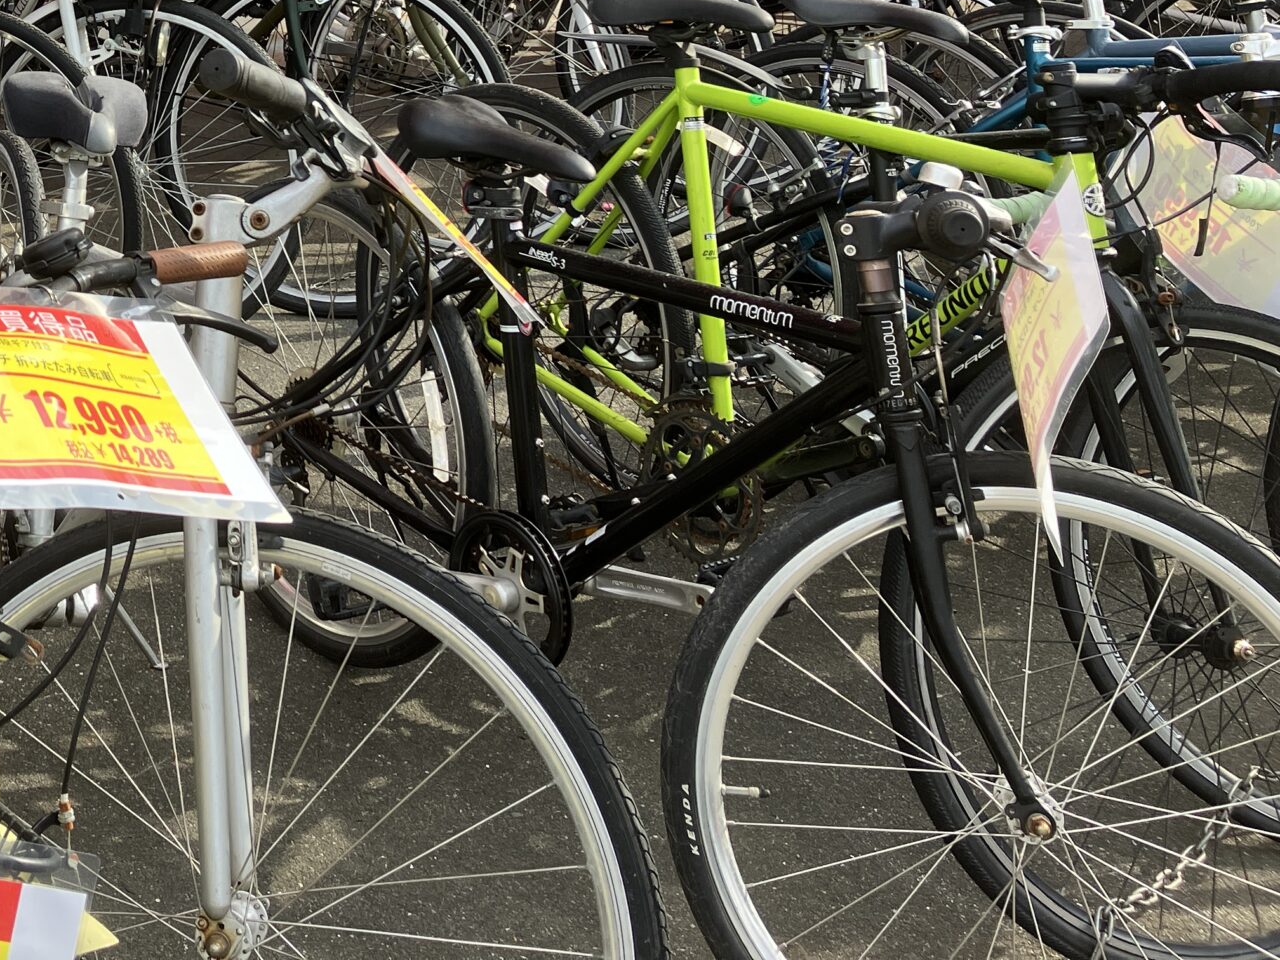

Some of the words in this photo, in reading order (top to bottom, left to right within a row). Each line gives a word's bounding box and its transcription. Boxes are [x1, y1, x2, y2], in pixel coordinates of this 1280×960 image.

[710, 295, 793, 329] momentum
[15, 354, 112, 382] 折りたたみ自転車
[23, 389, 155, 444] 12,990
[109, 441, 175, 471] 14,289
[681, 784, 700, 856] KENDA
